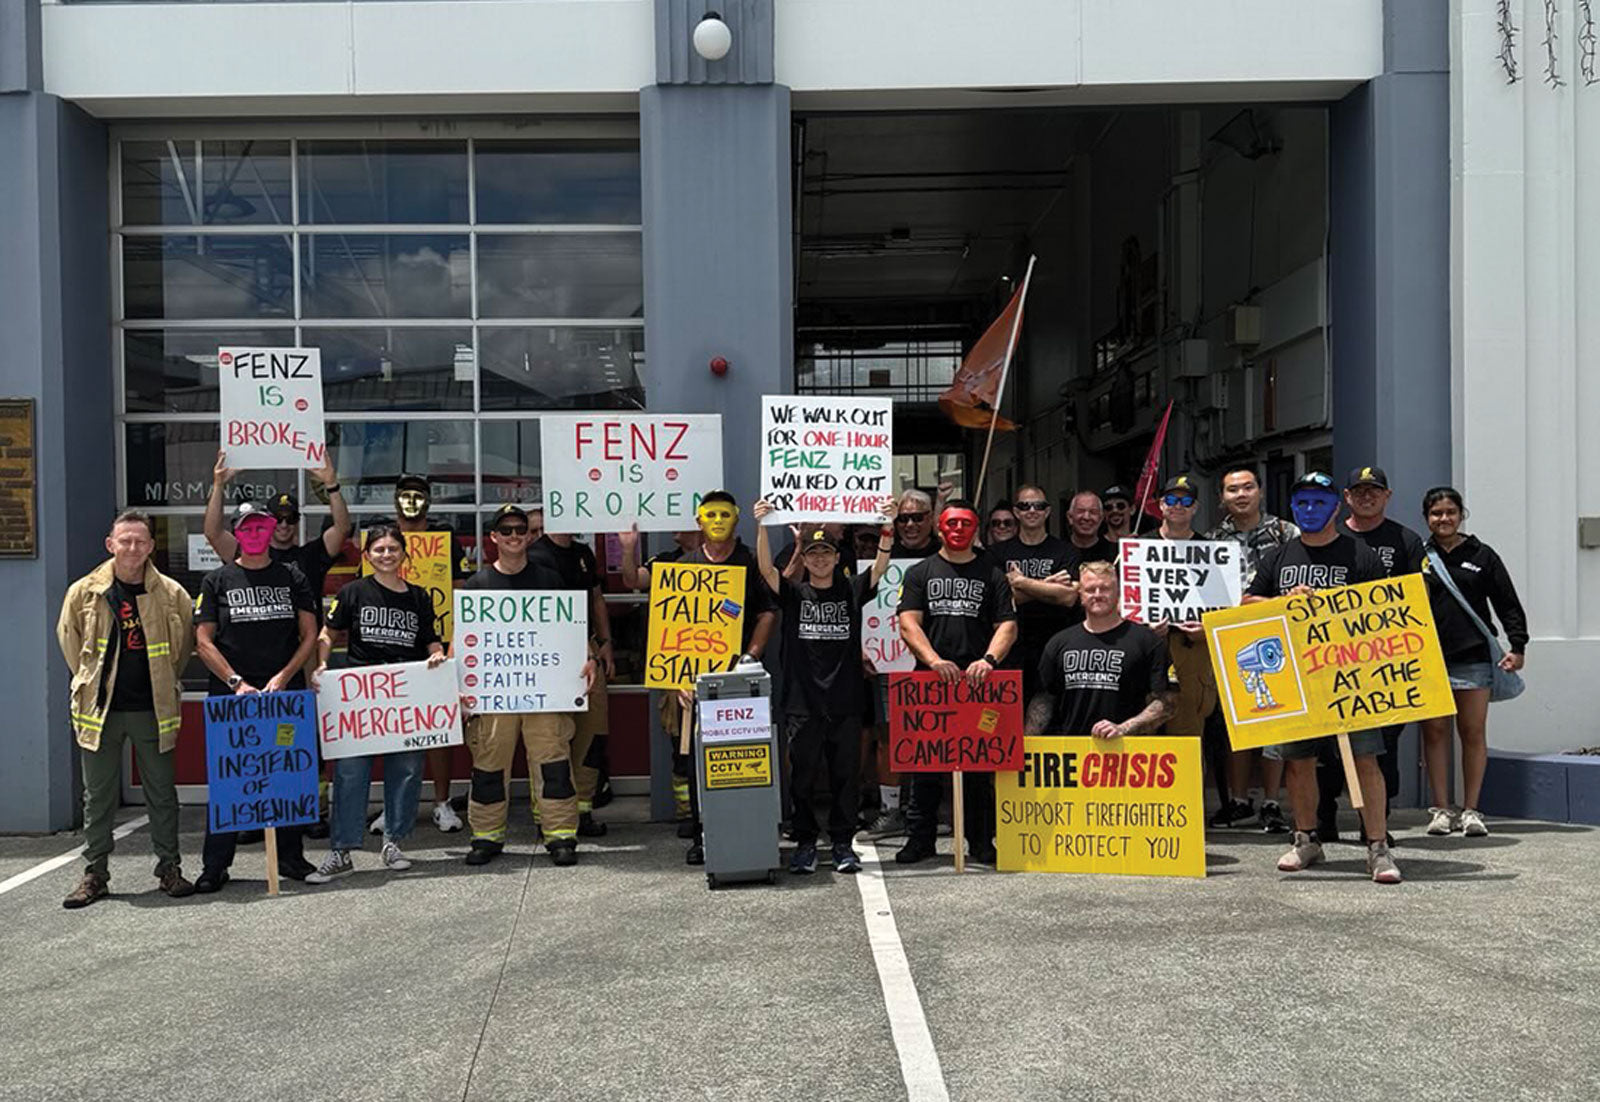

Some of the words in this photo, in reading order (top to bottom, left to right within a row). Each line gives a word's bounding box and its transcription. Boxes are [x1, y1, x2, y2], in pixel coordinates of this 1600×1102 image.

[234, 352, 314, 379] FENZ
[259, 385, 284, 407] IS
[770, 404, 799, 424] WE
[802, 407, 849, 424] WALK
[851, 407, 888, 426] OUT
[228, 420, 324, 462] BROKEN
[575, 422, 690, 461] FENZ
[768, 427, 799, 446] FOR
[803, 430, 844, 447] ONE
[847, 431, 891, 451] HOUR
[769, 448, 831, 469] FENZ
[842, 452, 882, 472] HAS
[619, 463, 644, 484] IS
[771, 472, 838, 490] WALKED
[845, 475, 886, 491] OUT
[796, 493, 841, 512] THREE
[1005, 558, 1055, 578] DIRE
[1279, 564, 1348, 588] DIRE
[659, 568, 729, 595] MORE
[927, 578, 985, 601] DIRE
[226, 586, 292, 607] DIRE
[928, 600, 982, 611] EMERGENCY
[1285, 589, 1362, 623] SPIED
[1369, 582, 1405, 605] ON
[230, 604, 293, 615] EMERGENCY
[360, 606, 419, 632] DIRE
[800, 600, 850, 623] DIRE
[360, 627, 417, 639] EMERGENC
[799, 623, 850, 633] EMERGENCY
[1307, 621, 1331, 645] AT
[661, 627, 729, 655] LESS
[483, 652, 561, 668] PROMISES
[1063, 649, 1125, 672] DIRE
[1302, 632, 1425, 675] IGNORED
[338, 670, 409, 702] DIRE
[483, 672, 537, 688] FAITH
[1333, 668, 1361, 694] AT
[1371, 658, 1422, 687] THE
[480, 693, 548, 711] TRUST
[891, 677, 951, 706] TRUST
[1328, 686, 1427, 720] TABLE
[207, 694, 305, 723] WATCHING
[716, 707, 754, 722] FENZ
[322, 703, 458, 743] EMERGENCY
[702, 729, 729, 737] MOBILE
[731, 728, 752, 736] CCTV
[753, 726, 771, 734] UNIT
[903, 709, 958, 734] NOT
[228, 724, 261, 749] US
[403, 733, 449, 748] #NZPFU
[711, 748, 765, 760] WARNING
[894, 735, 1017, 766] CAMERAS!
[218, 748, 313, 779] INSTEAD
[711, 762, 743, 773] CCTV
[243, 777, 271, 796] OF
[214, 794, 317, 831] LISTENING
[1001, 800, 1075, 825] SUPPORT
[1086, 802, 1188, 828] FIREFIGHTERS
[1018, 832, 1042, 856] TO
[1055, 834, 1132, 858] PROTECT
[1145, 836, 1181, 860] YOU
